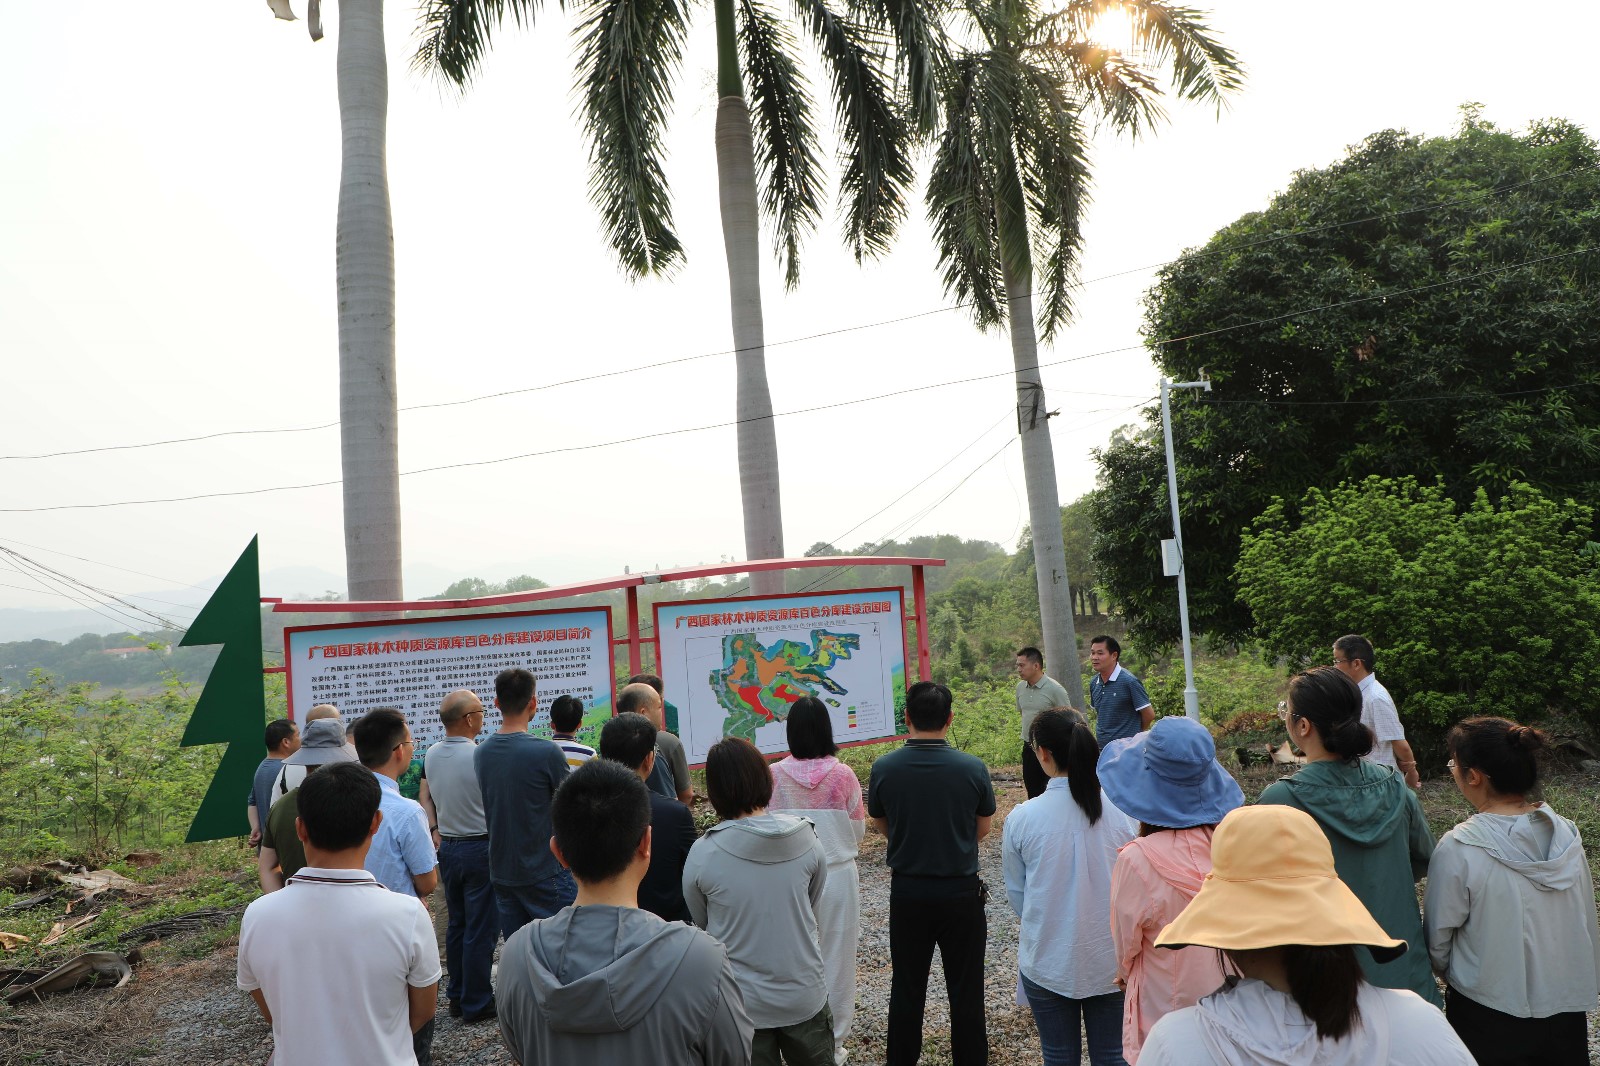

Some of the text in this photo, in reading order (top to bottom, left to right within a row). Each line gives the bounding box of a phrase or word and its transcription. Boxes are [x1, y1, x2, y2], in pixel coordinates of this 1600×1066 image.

[675, 601, 892, 629] 广西国家林木种质资源库百色分库建设范围图
[308, 626, 592, 660] 广西国家林木种质资源库百色分库建设项目简介
